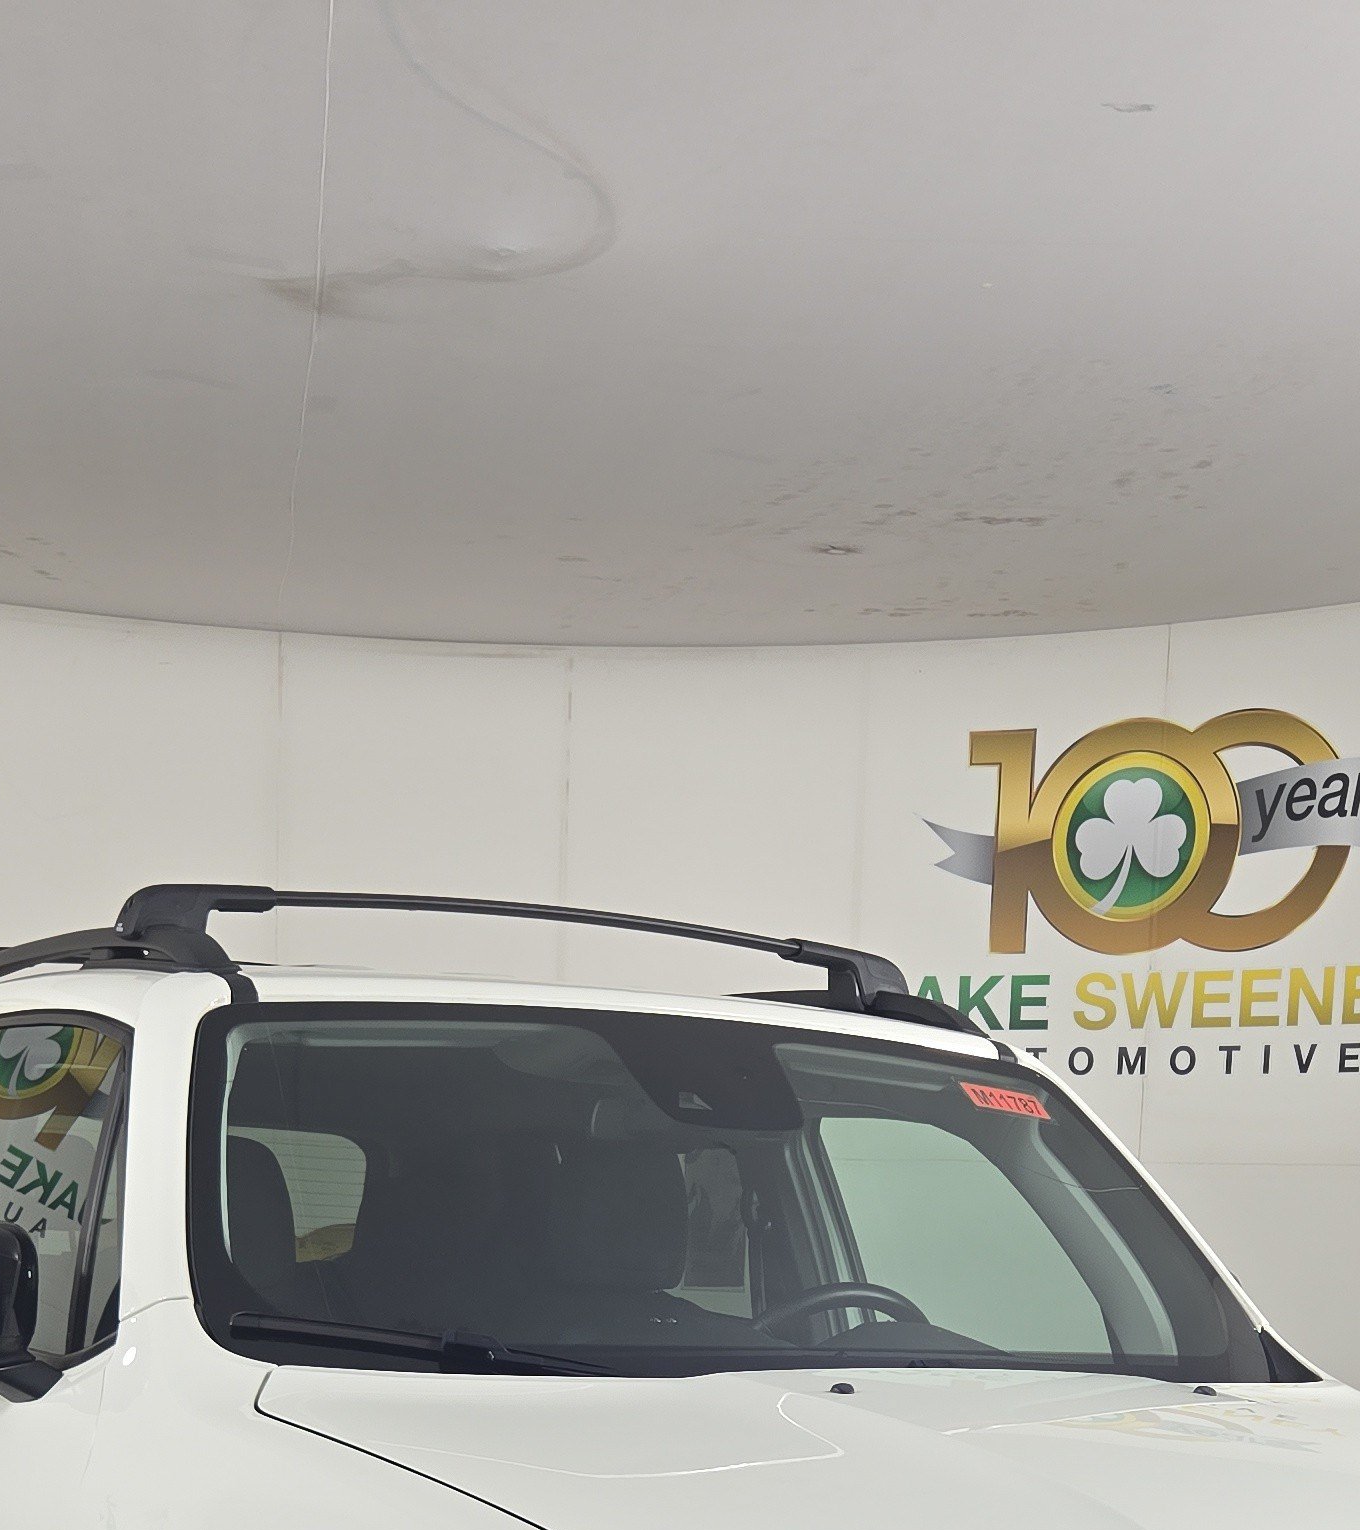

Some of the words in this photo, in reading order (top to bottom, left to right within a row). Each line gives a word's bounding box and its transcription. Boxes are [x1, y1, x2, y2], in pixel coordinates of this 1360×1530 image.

[968, 708, 1352, 955] 100
[917, 974, 1050, 1031] AKE
[971, 1088, 1042, 1116] M11787
